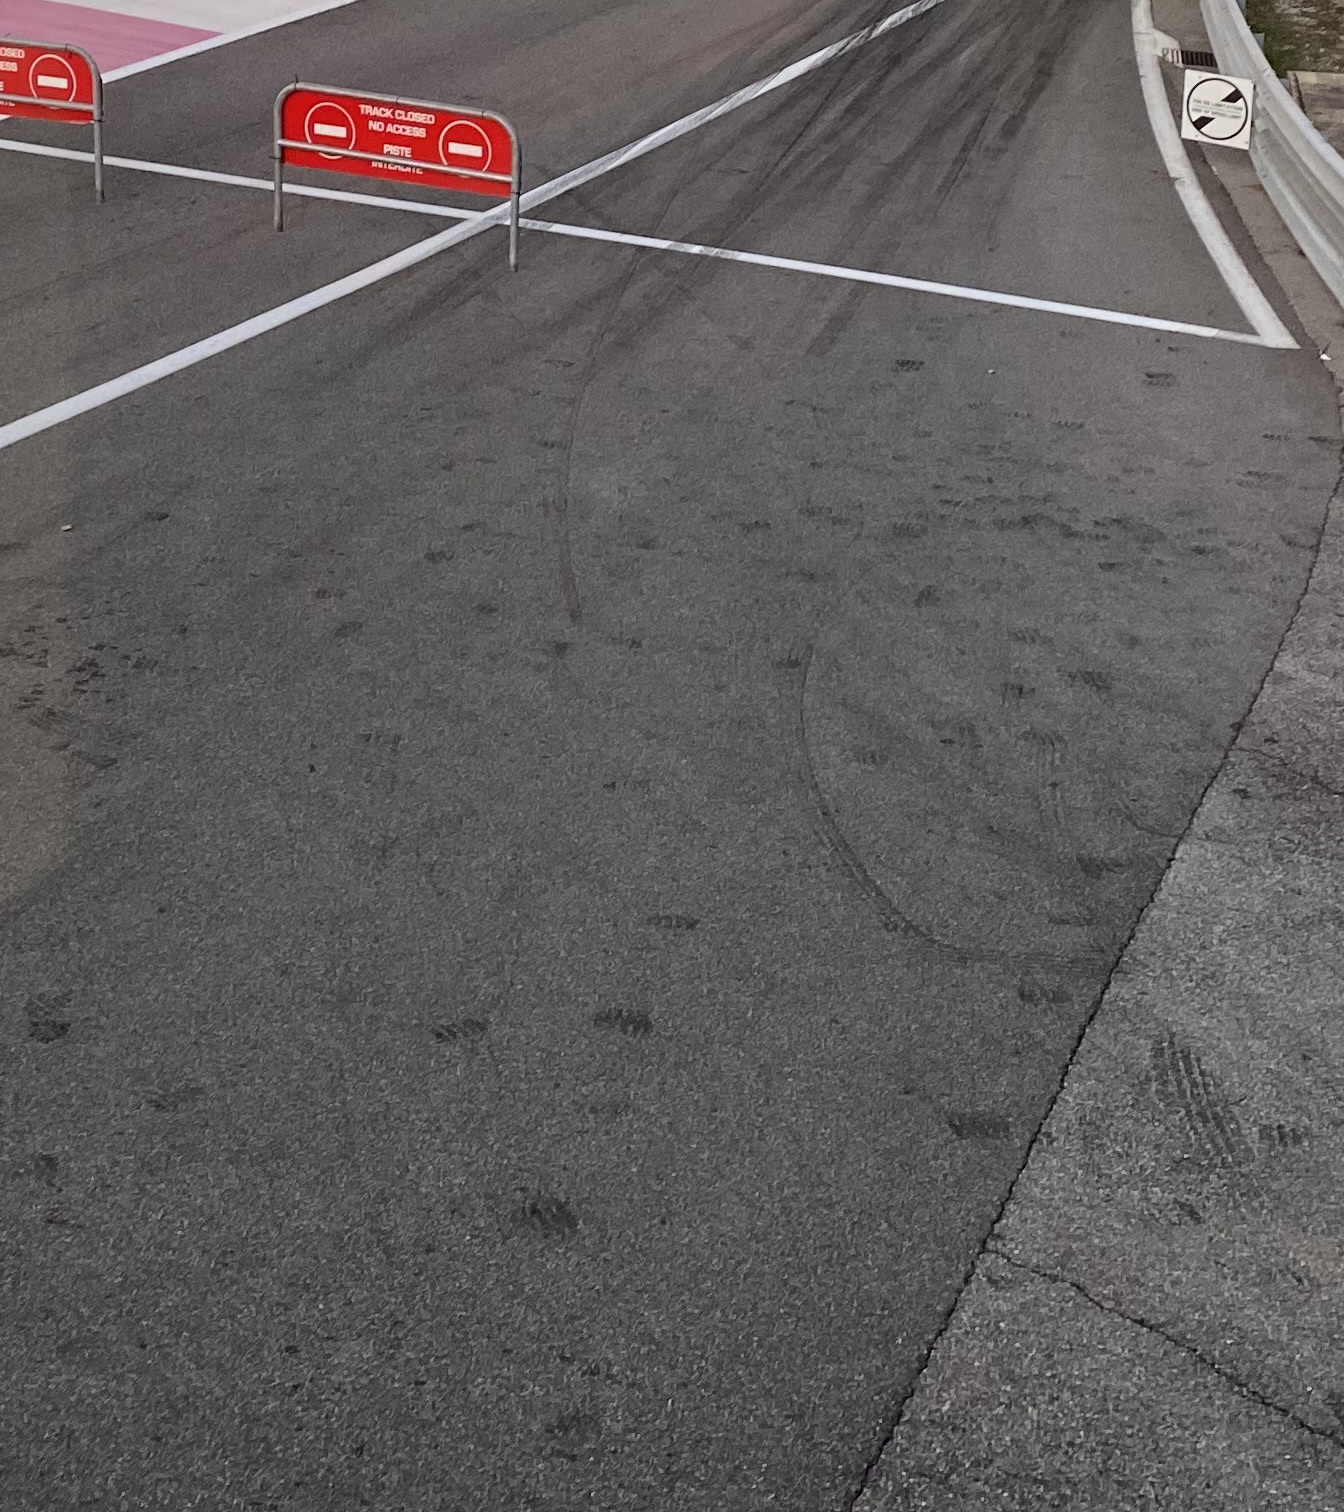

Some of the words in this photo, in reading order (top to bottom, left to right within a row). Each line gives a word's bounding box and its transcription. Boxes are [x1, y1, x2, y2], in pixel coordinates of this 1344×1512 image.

[358, 103, 394, 119] TRACK
[394, 109, 435, 125] CLOSED
[368, 120, 385, 132] NO
[385, 123, 426, 138] ACCESS
[383, 143, 412, 158] PISTE
